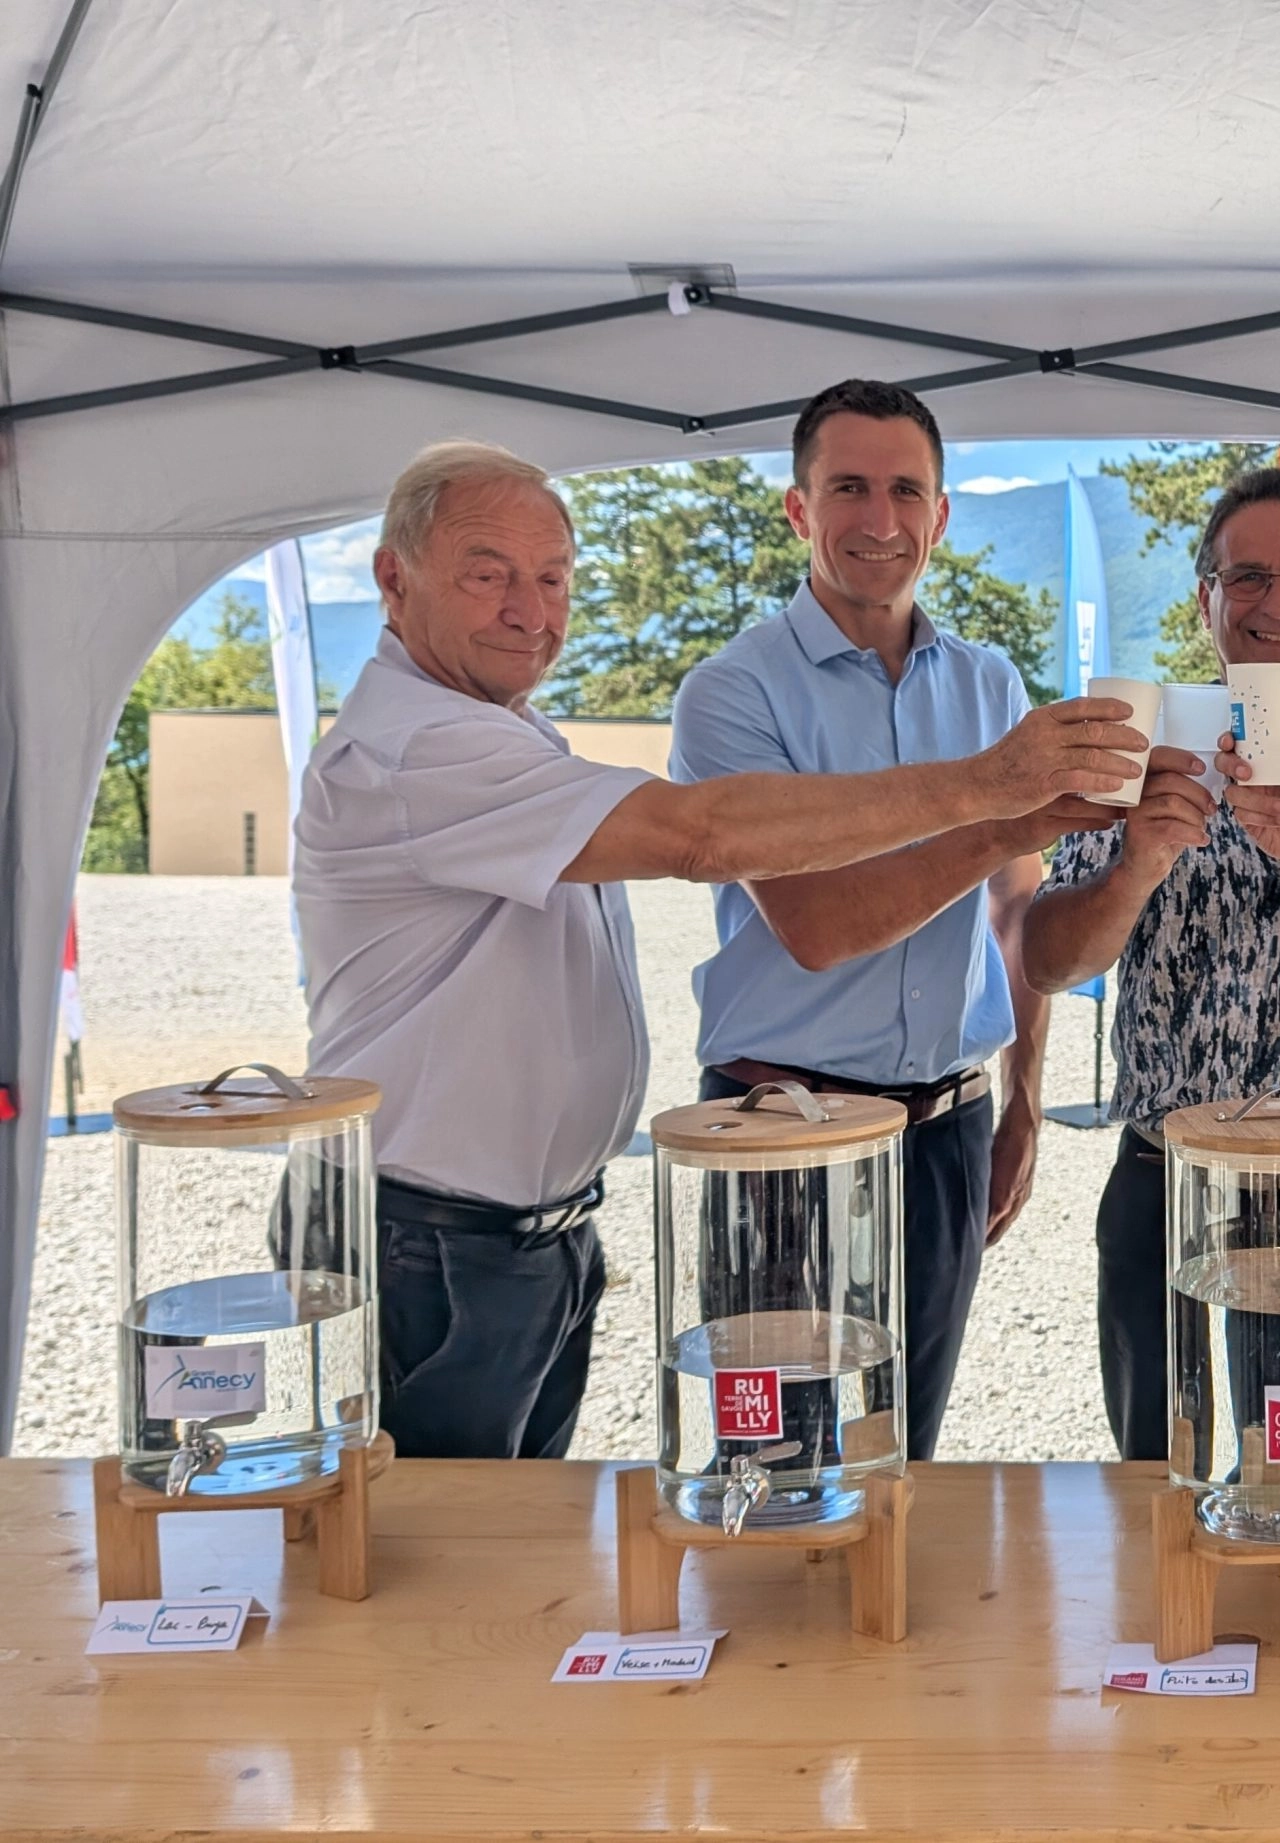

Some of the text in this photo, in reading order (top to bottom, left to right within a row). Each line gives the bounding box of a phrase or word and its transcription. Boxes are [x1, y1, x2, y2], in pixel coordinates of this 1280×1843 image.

[178, 1371, 256, 1390] Annecy
[735, 1378, 763, 1395] RU
[745, 1394, 769, 1411] MI
[736, 1411, 772, 1428] LLY
[157, 1617, 180, 1630] Lac
